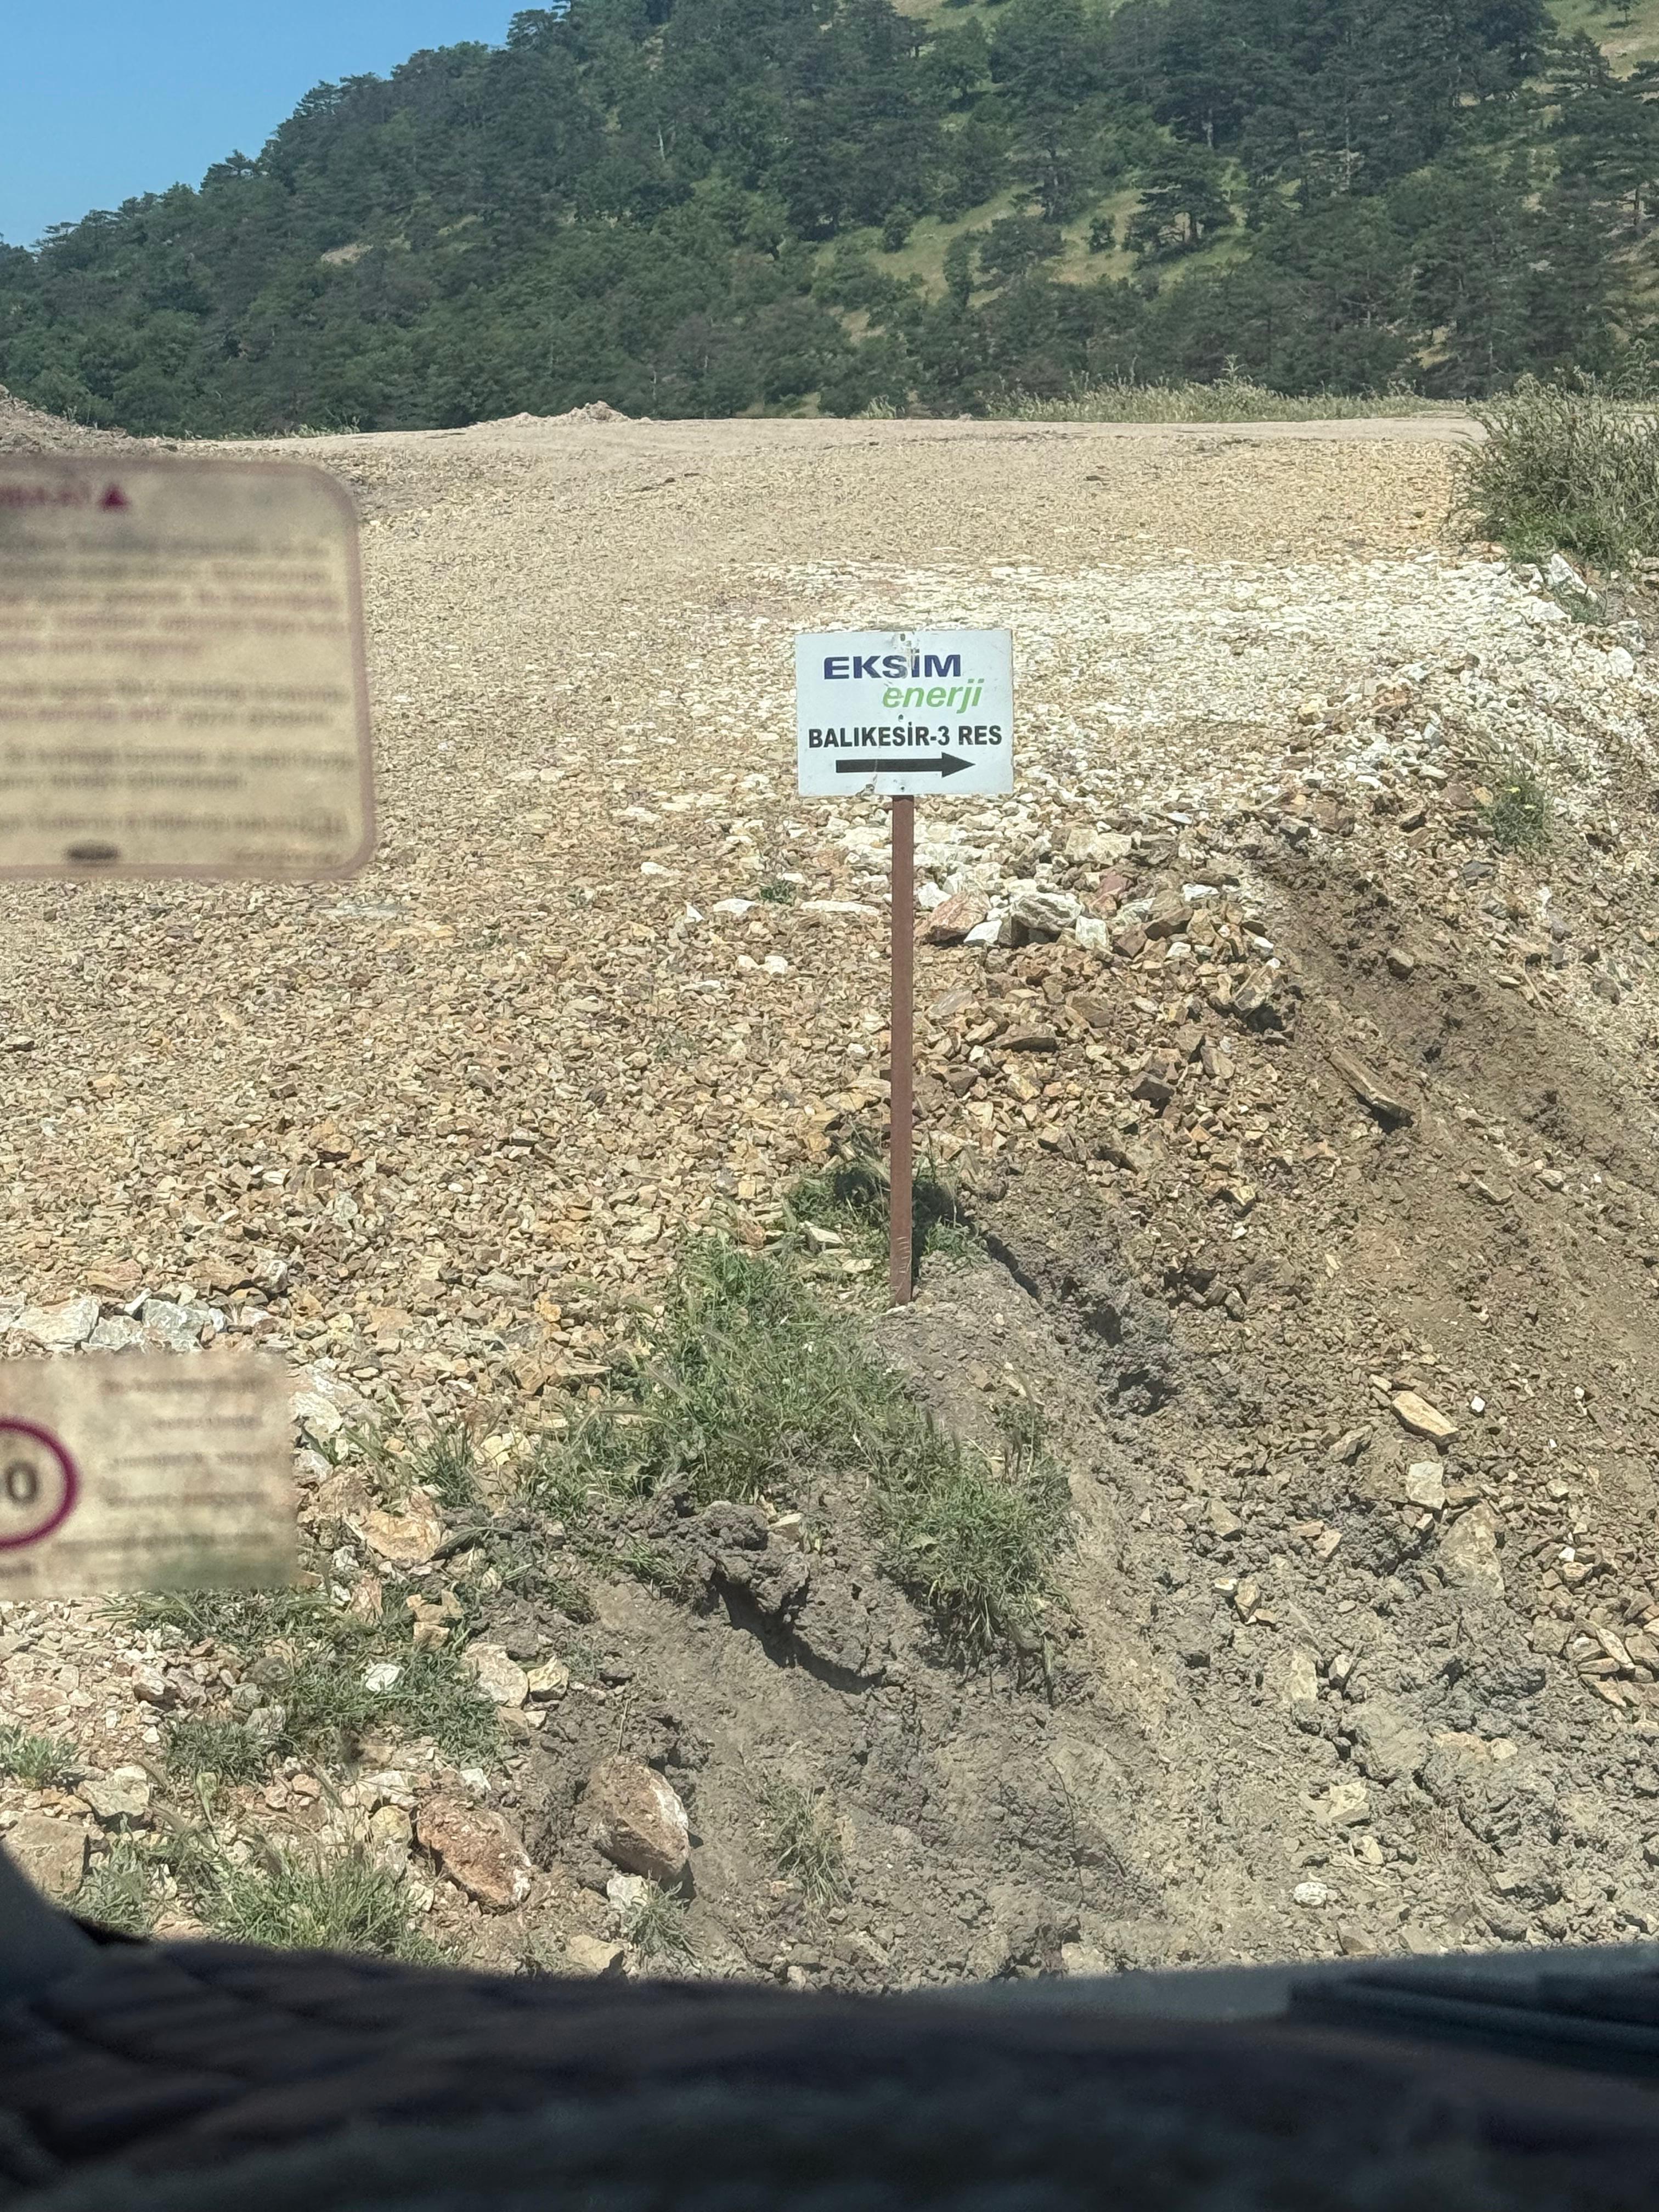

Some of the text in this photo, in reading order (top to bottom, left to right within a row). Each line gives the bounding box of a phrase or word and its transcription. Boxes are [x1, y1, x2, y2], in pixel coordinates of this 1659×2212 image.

[883, 678, 985, 714] enerji
[808, 721, 1002, 748] BALIKESİR-3 RES
